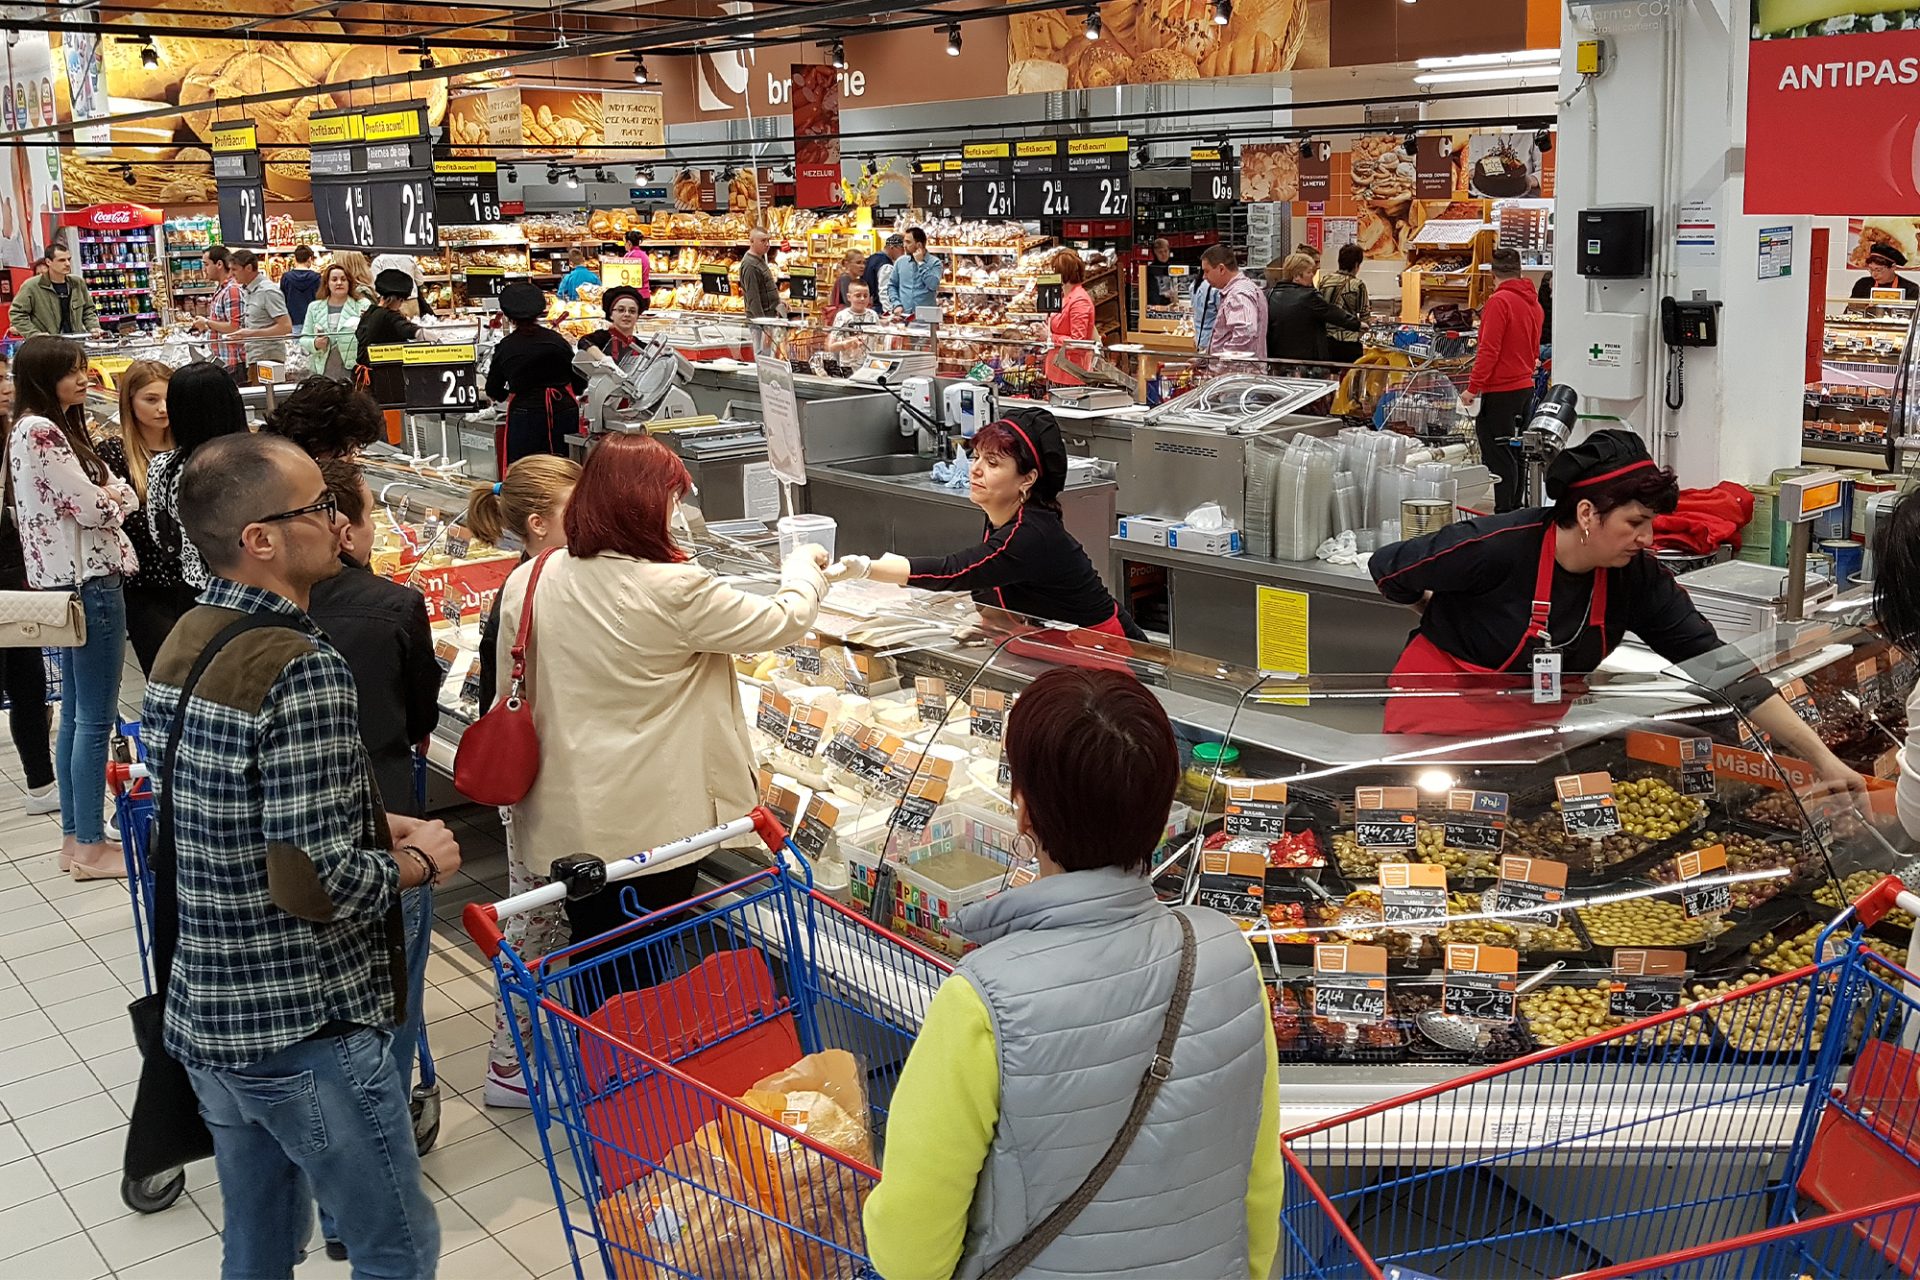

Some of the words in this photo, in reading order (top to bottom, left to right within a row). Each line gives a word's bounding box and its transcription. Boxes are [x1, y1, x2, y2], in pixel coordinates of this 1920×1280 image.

[1580, 6, 1631, 21] Aarma
[1778, 57, 1920, 91] ANTIPAS
[802, 170, 834, 178] MEZELURI
[1212, 176, 1220, 199] 0
[1221, 186, 1232, 199] 99
[470, 193, 480, 221] 1
[484, 206, 500, 221] 89
[987, 181, 998, 215] 2
[999, 197, 1011, 216] 91
[1042, 180, 1054, 215] 2
[1055, 195, 1070, 214] 44
[1100, 179, 1112, 215] 2
[1113, 194, 1128, 214] 27
[241, 189, 252, 241] 2
[345, 186, 358, 245] 1
[357, 214, 374, 246] 29
[402, 183, 417, 245] 2
[418, 211, 434, 245] 45
[489, 278, 495, 294] 1
[620, 269, 630, 286] 9
[802, 279, 809, 297] 3
[1044, 288, 1050, 309] 1
[442, 370, 457, 405] 2
[458, 385, 477, 403] 09
